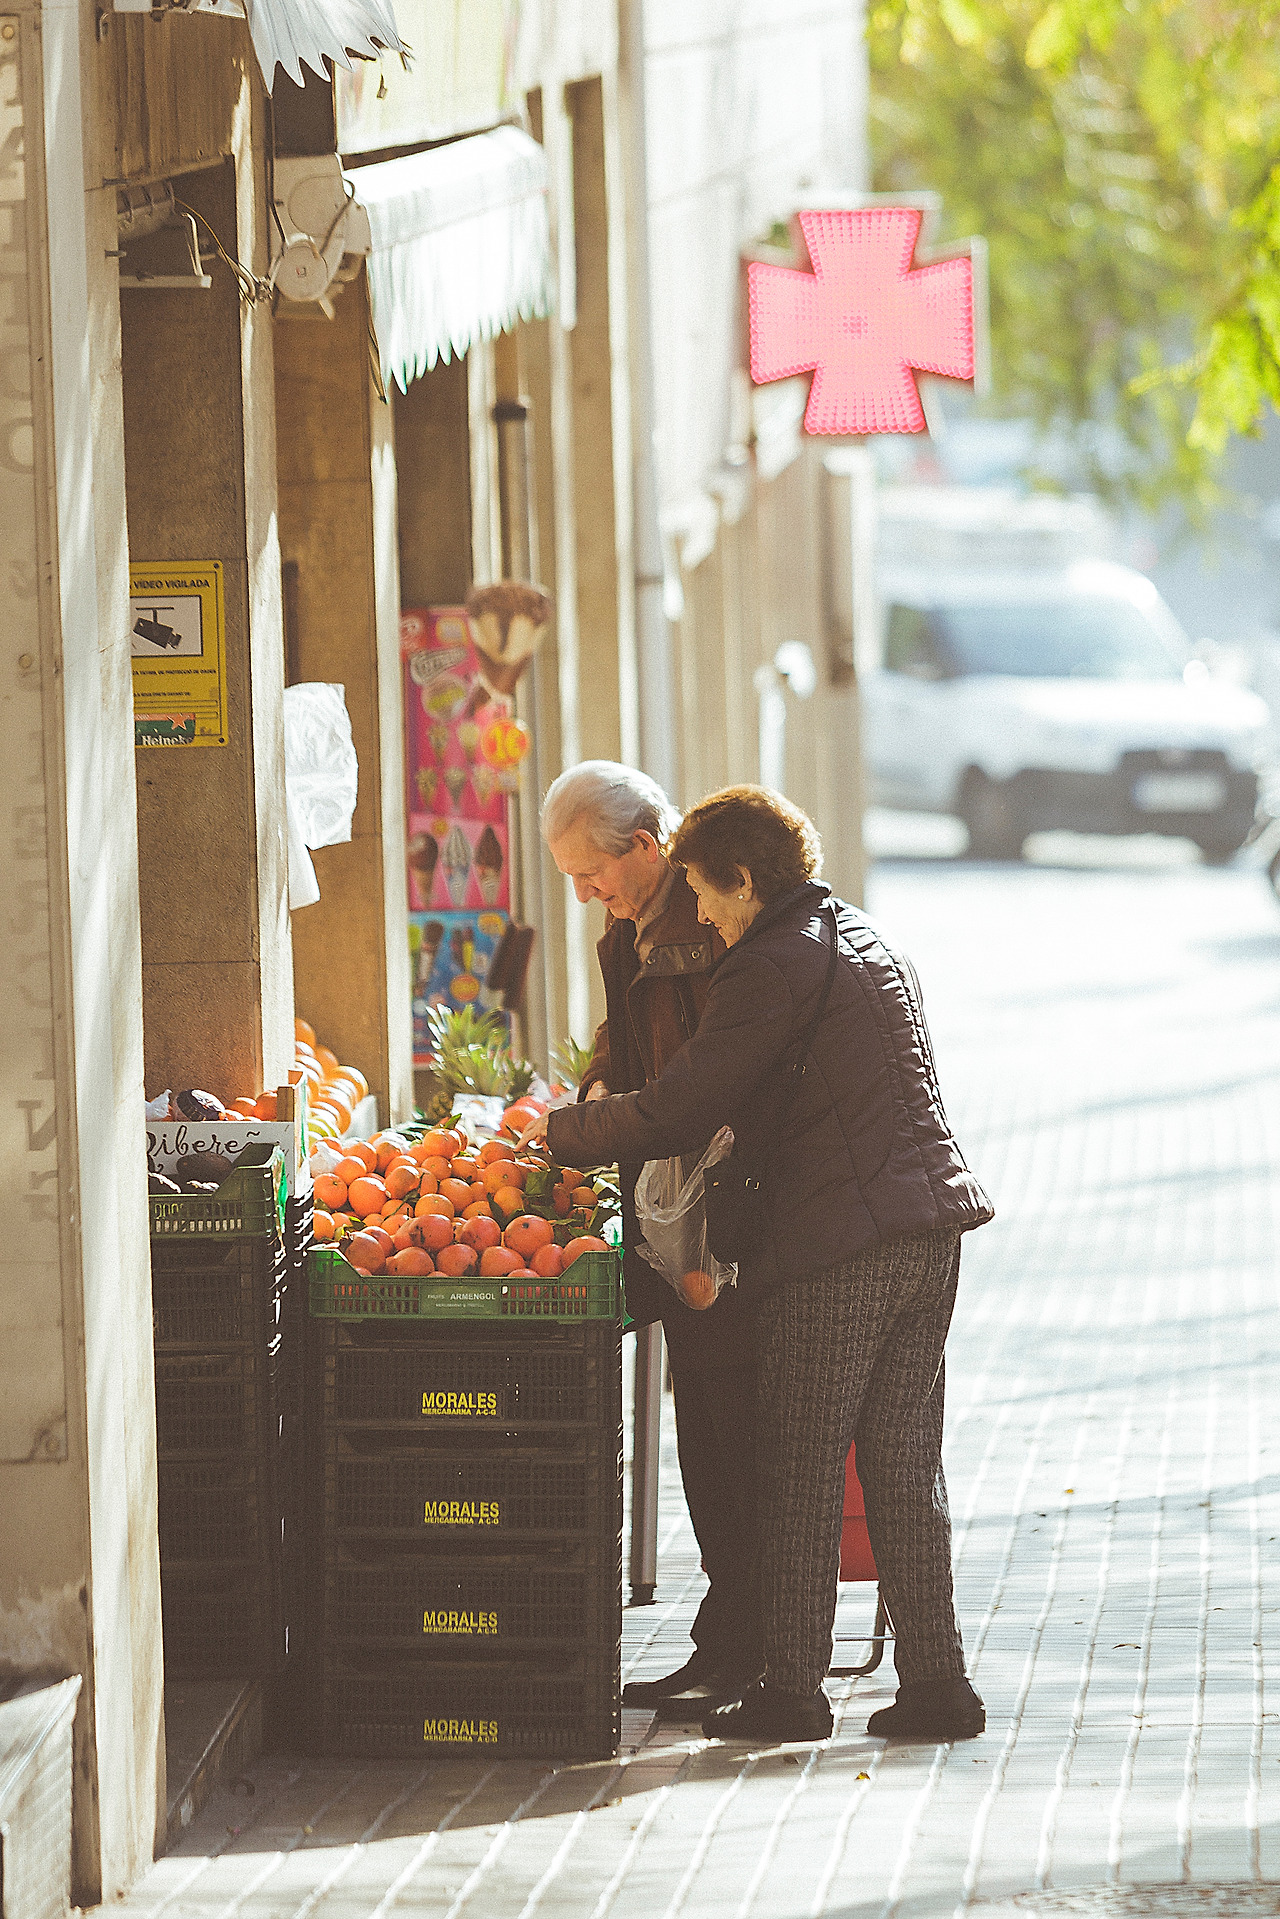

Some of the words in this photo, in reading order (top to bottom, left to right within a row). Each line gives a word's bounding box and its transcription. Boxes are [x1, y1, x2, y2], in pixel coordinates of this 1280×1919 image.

[164, 579, 210, 588] VIGILADA
[146, 1124, 261, 1174] ibere
[450, 1292, 496, 1300] ARMENGOL
[422, 1392, 497, 1409] MORALES
[424, 1501, 500, 1518] MORALES
[423, 1610, 498, 1628] MORALES
[423, 1719, 498, 1737] MORALES
